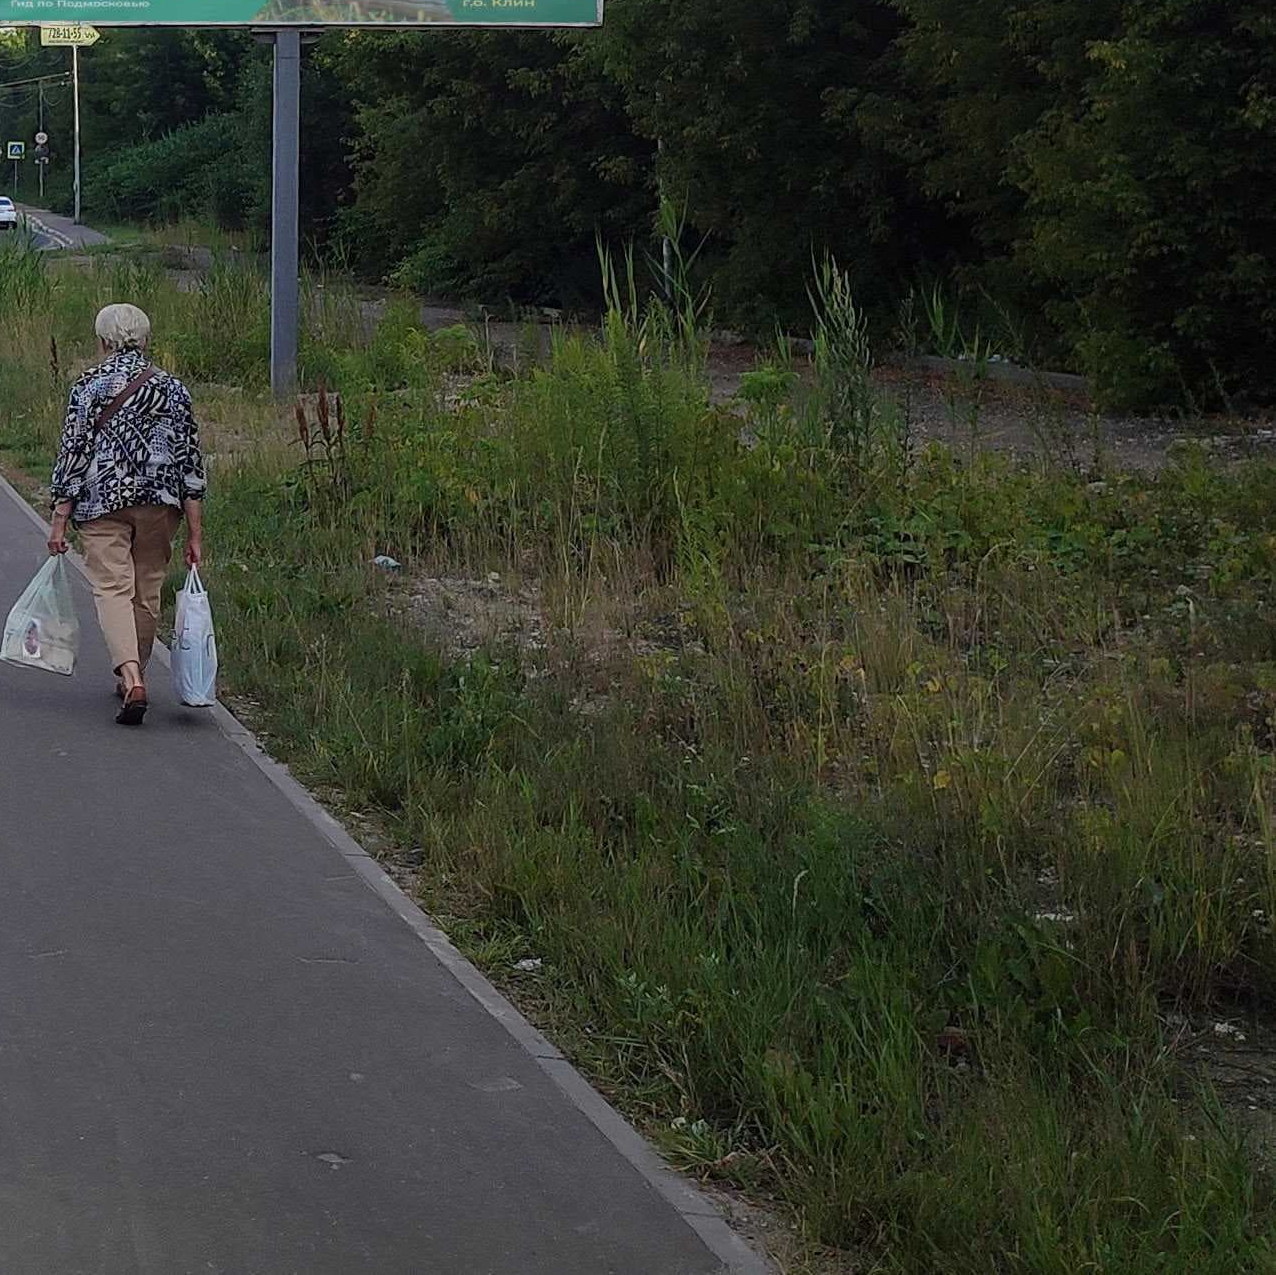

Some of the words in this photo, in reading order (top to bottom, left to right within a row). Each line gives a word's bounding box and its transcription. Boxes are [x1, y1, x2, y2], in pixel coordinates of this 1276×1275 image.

[10, 0, 34, 9] Гид
[37, 0, 54, 8] по
[56, 0, 151, 9] Подмосковью
